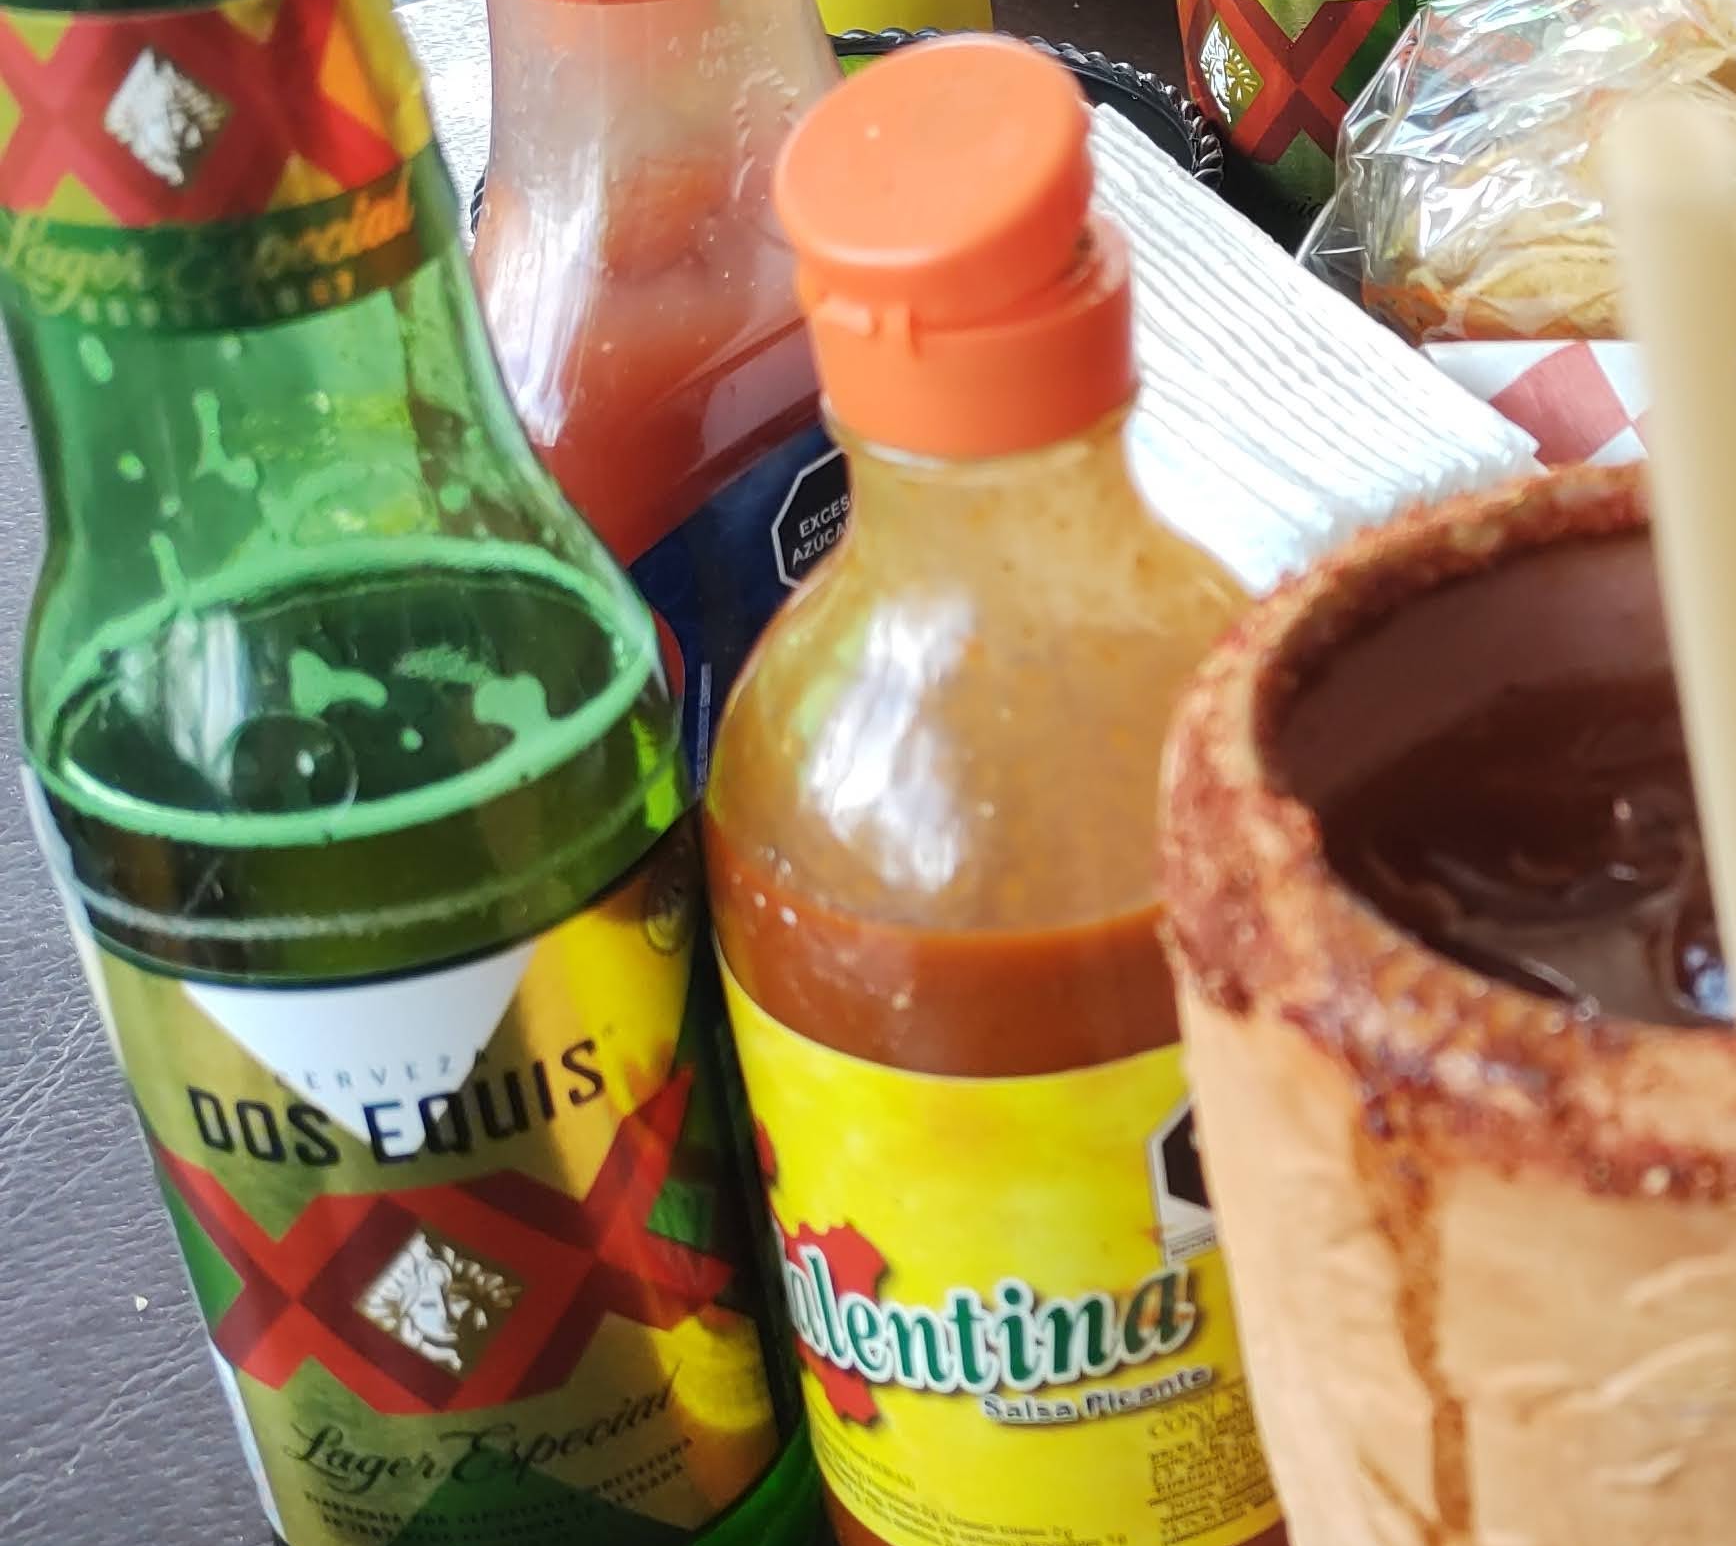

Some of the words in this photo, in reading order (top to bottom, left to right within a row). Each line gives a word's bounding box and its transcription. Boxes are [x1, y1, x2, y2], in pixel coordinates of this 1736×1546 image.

[186, 1083, 342, 1169] DOS
[361, 1036, 606, 1167] EQUIS
[282, 1421, 450, 1497] Lager
[439, 1357, 682, 1489] Especial
[980, 1389, 1080, 1425] Salsa
